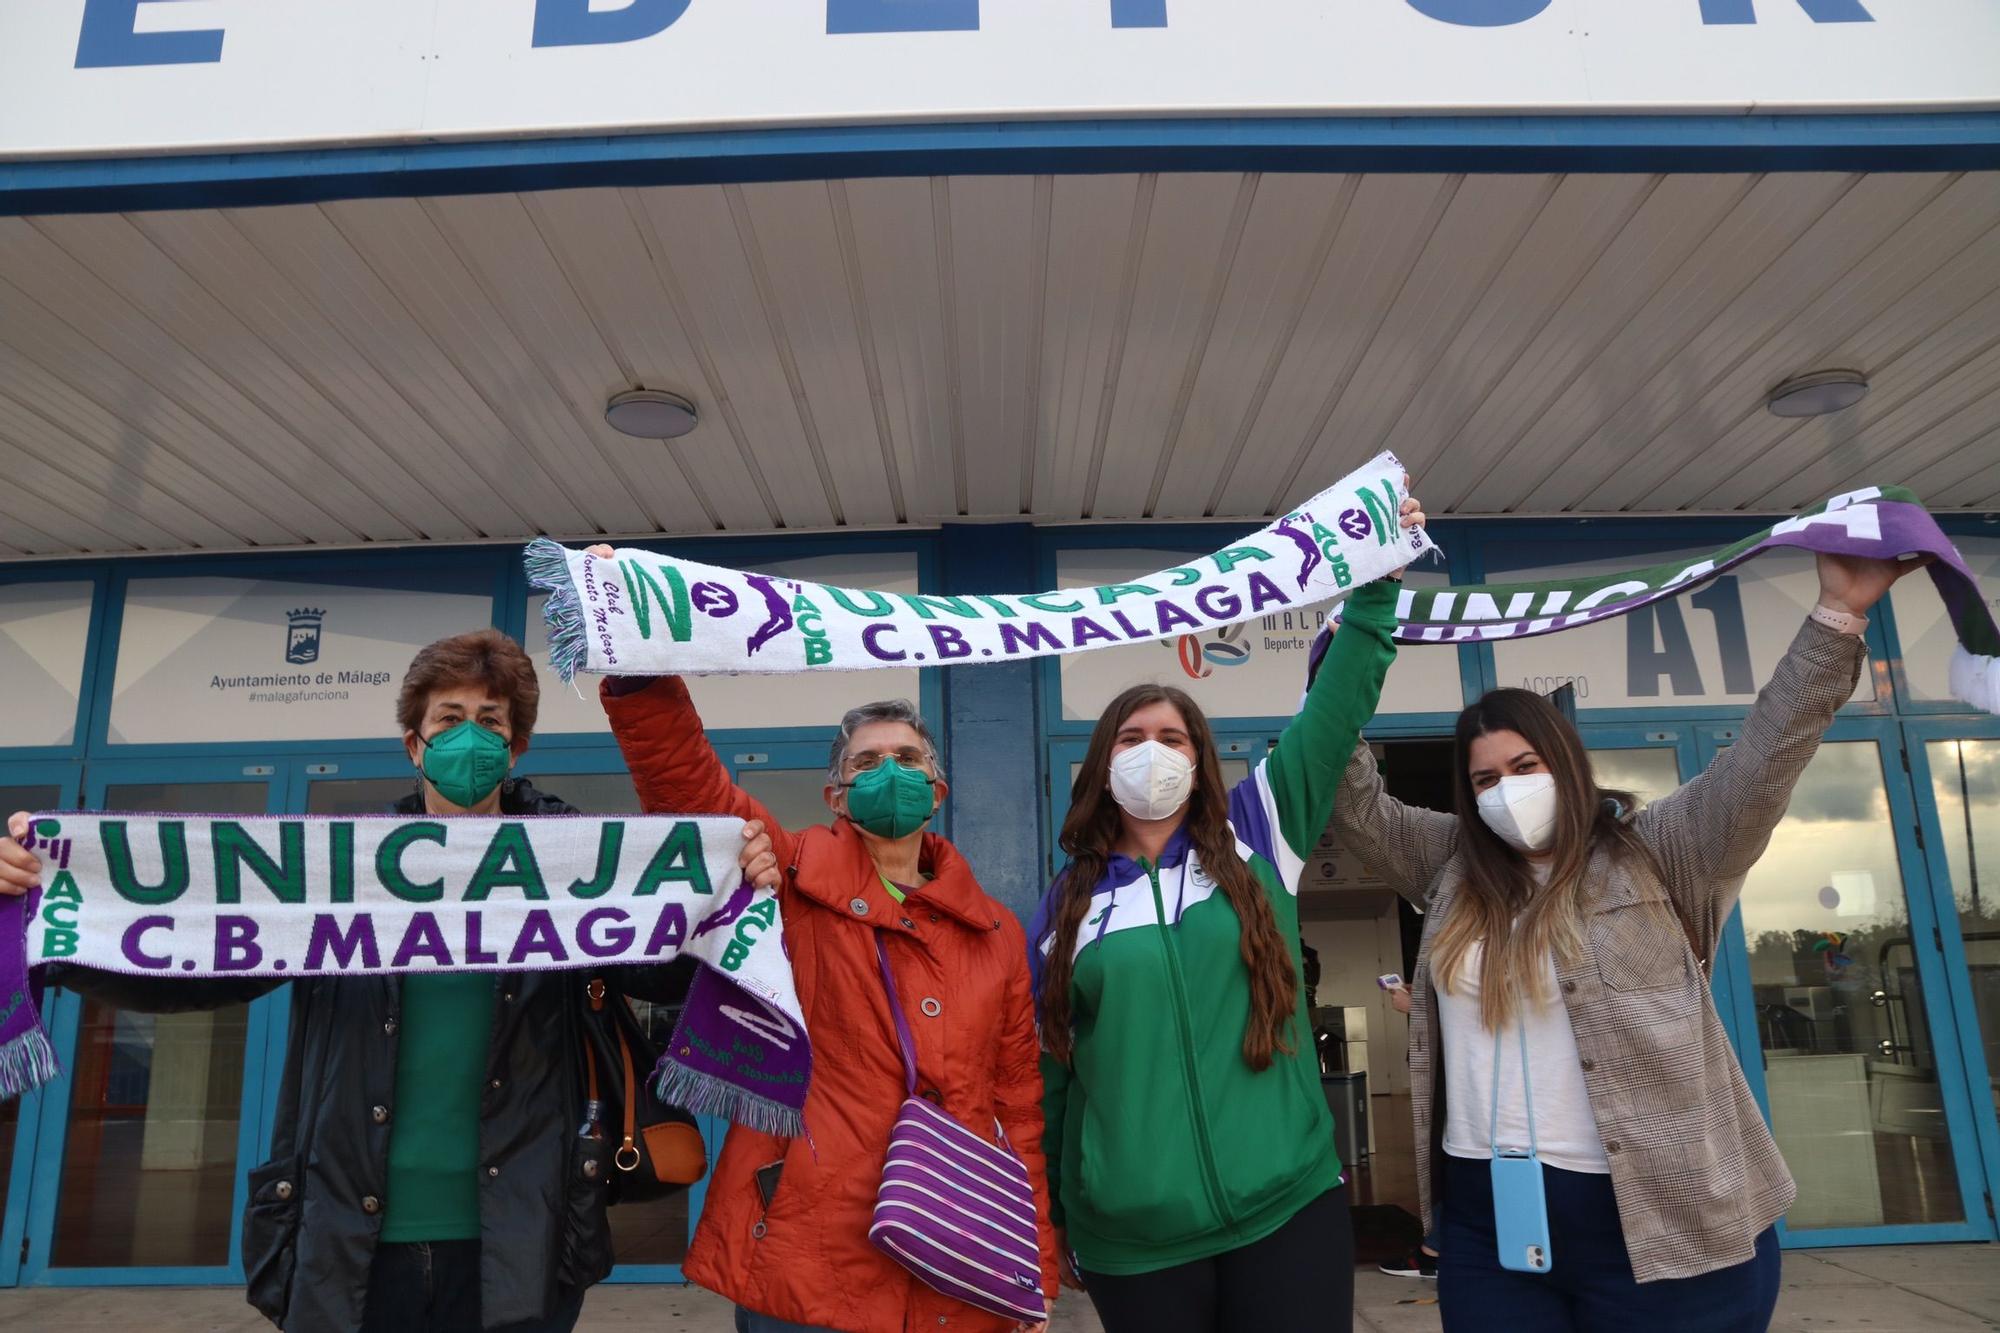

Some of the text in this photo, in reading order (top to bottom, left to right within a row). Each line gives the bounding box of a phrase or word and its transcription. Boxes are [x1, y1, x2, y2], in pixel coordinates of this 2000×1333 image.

[1311, 521, 1352, 588] ACB
[602, 581, 624, 615] Club
[792, 594, 833, 665] ACB
[1264, 636, 1304, 652] Deporte
[1627, 575, 1756, 696] A1
[210, 670, 391, 690] Ayuntamiento de Málaga
[249, 689, 349, 704] #malagafunciona
[100, 820, 714, 905] UNICAJA
[41, 870, 84, 958] ACB
[120, 902, 688, 972] C.B.MALAGA
[719, 897, 776, 972] ACB
